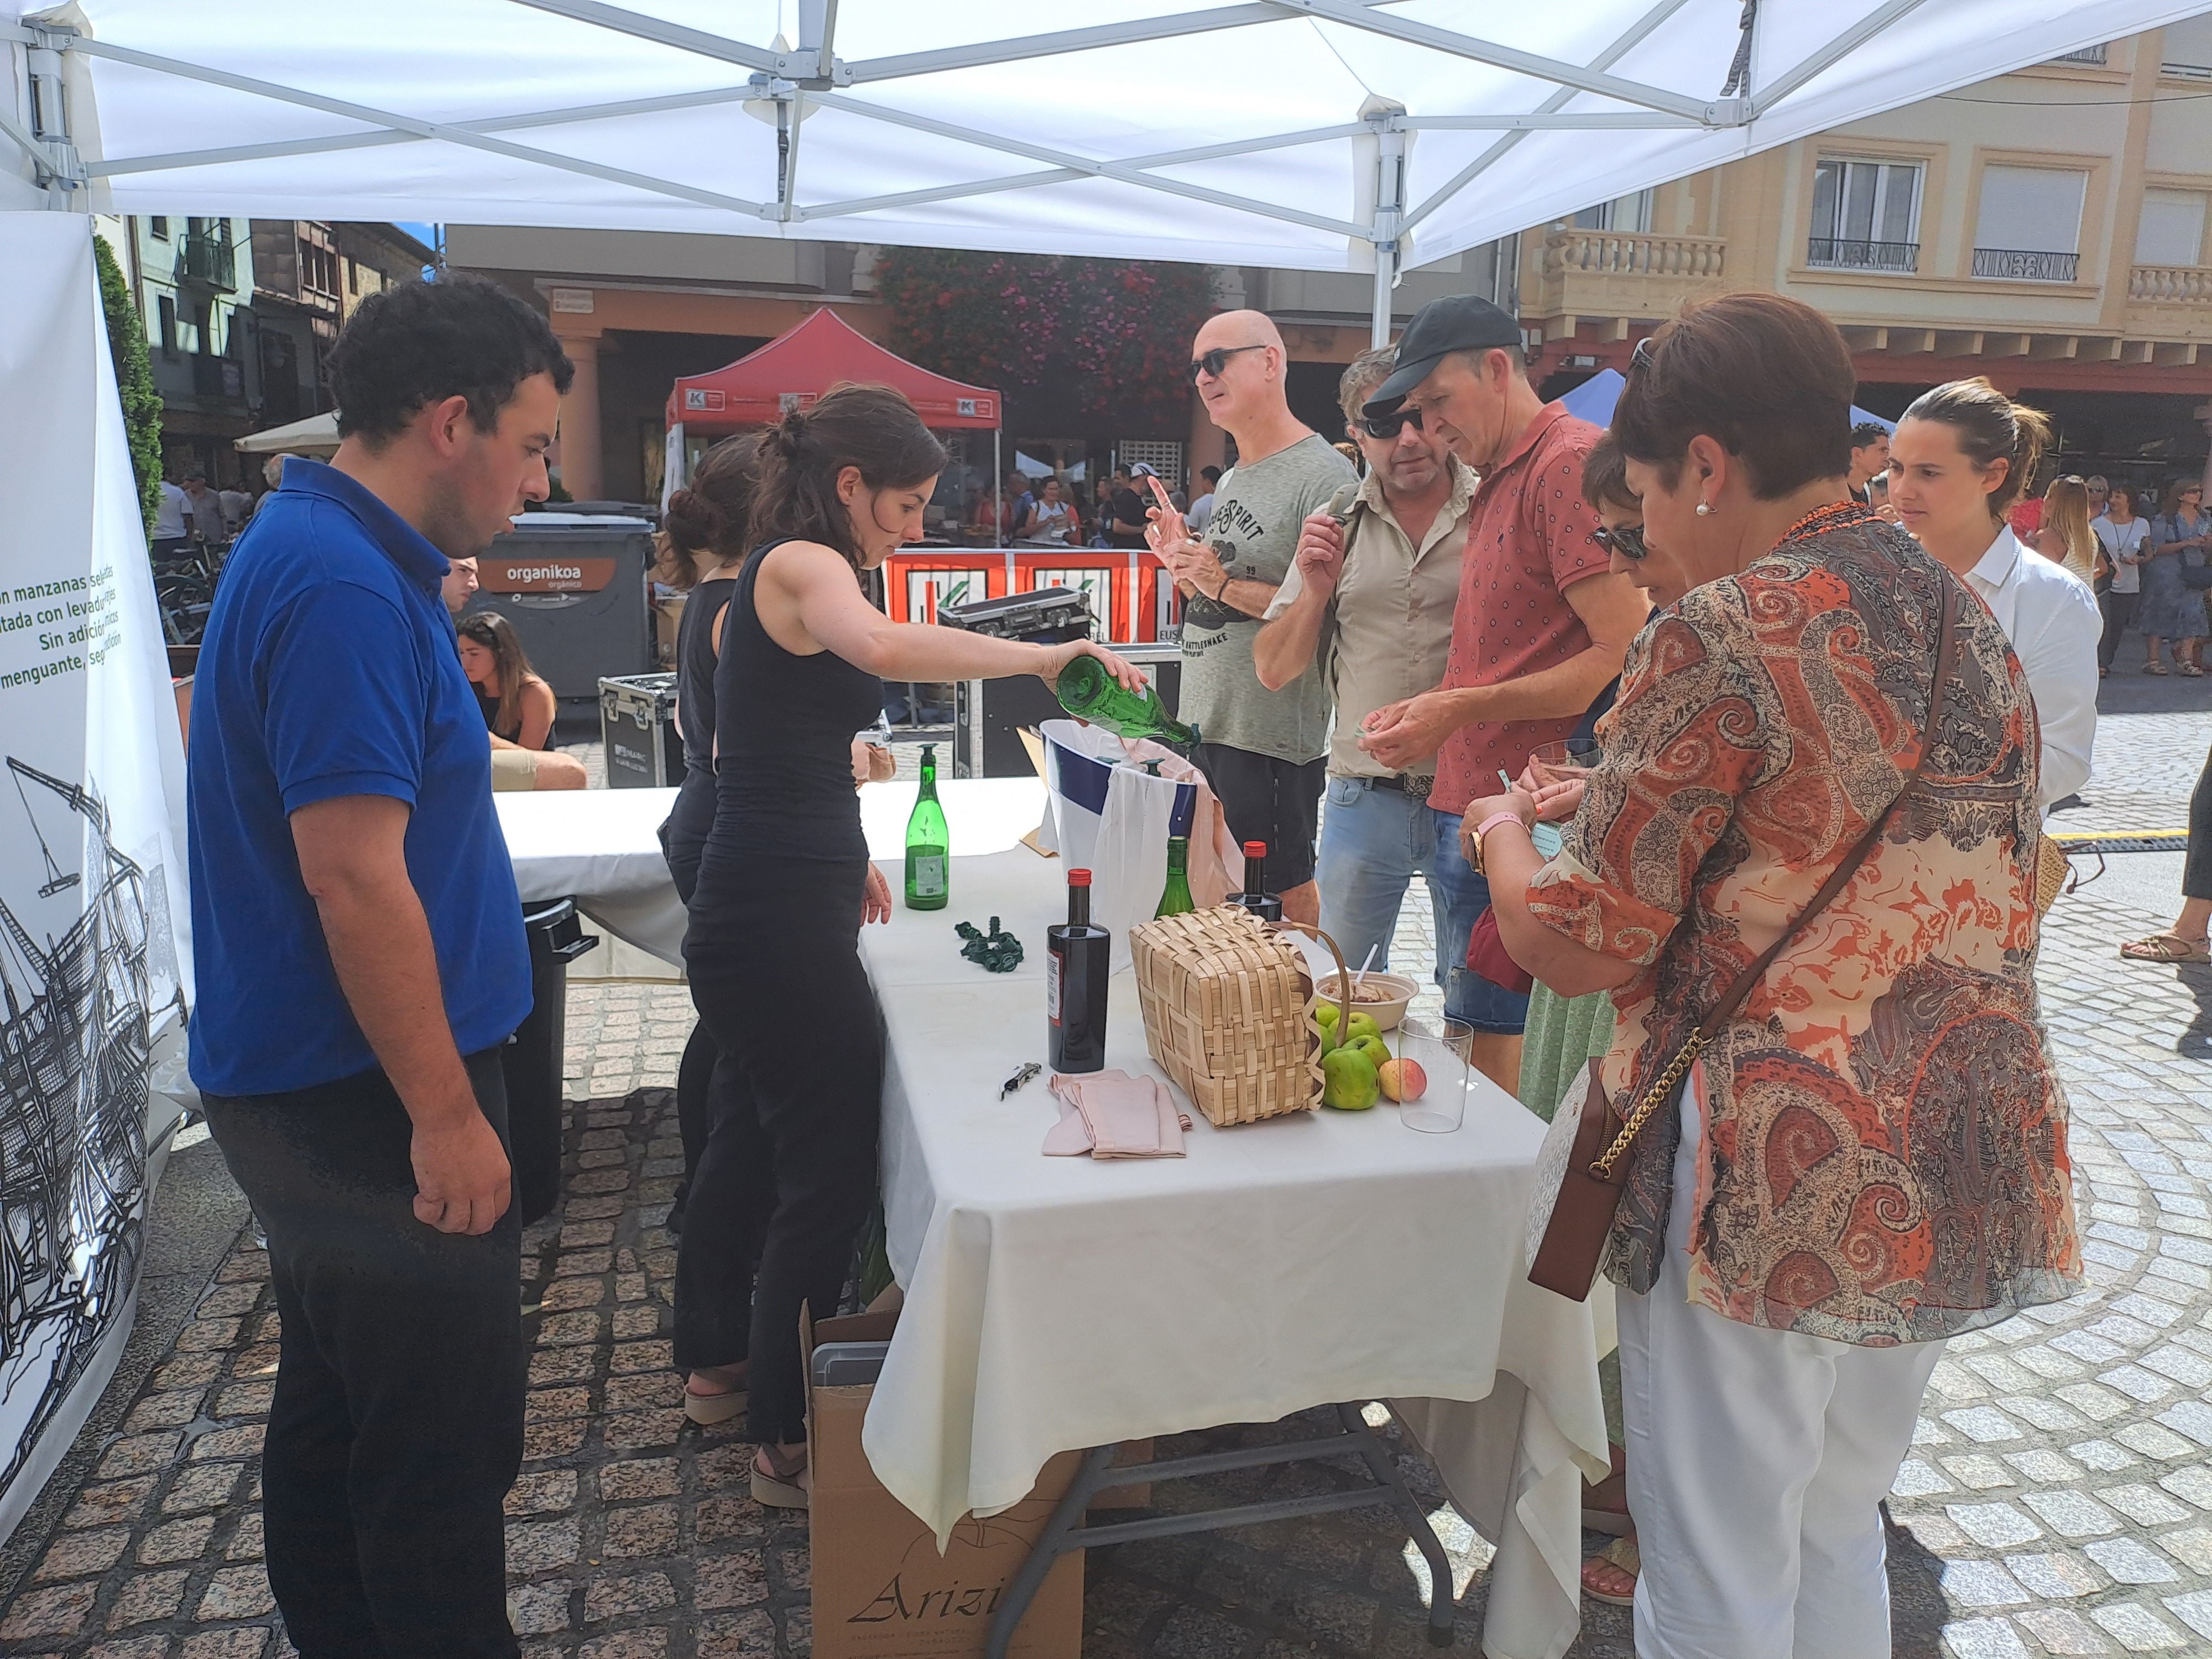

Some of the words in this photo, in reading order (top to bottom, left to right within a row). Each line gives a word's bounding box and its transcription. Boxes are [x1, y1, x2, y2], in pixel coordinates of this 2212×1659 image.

[1219, 500, 1264, 541] SPIRIT
[507, 564, 581, 583] organikoa
[1246, 566, 1256, 575] 99
[0, 591, 10, 605] n
[13, 576, 87, 603] manzanas
[0, 611, 33, 634] tada
[37, 607, 64, 625] con
[39, 632, 65, 651] Sin
[1160, 630, 1177, 640] EUS
[1, 655, 87, 690] menguante,
[847, 1572, 1005, 1623] Arizi
